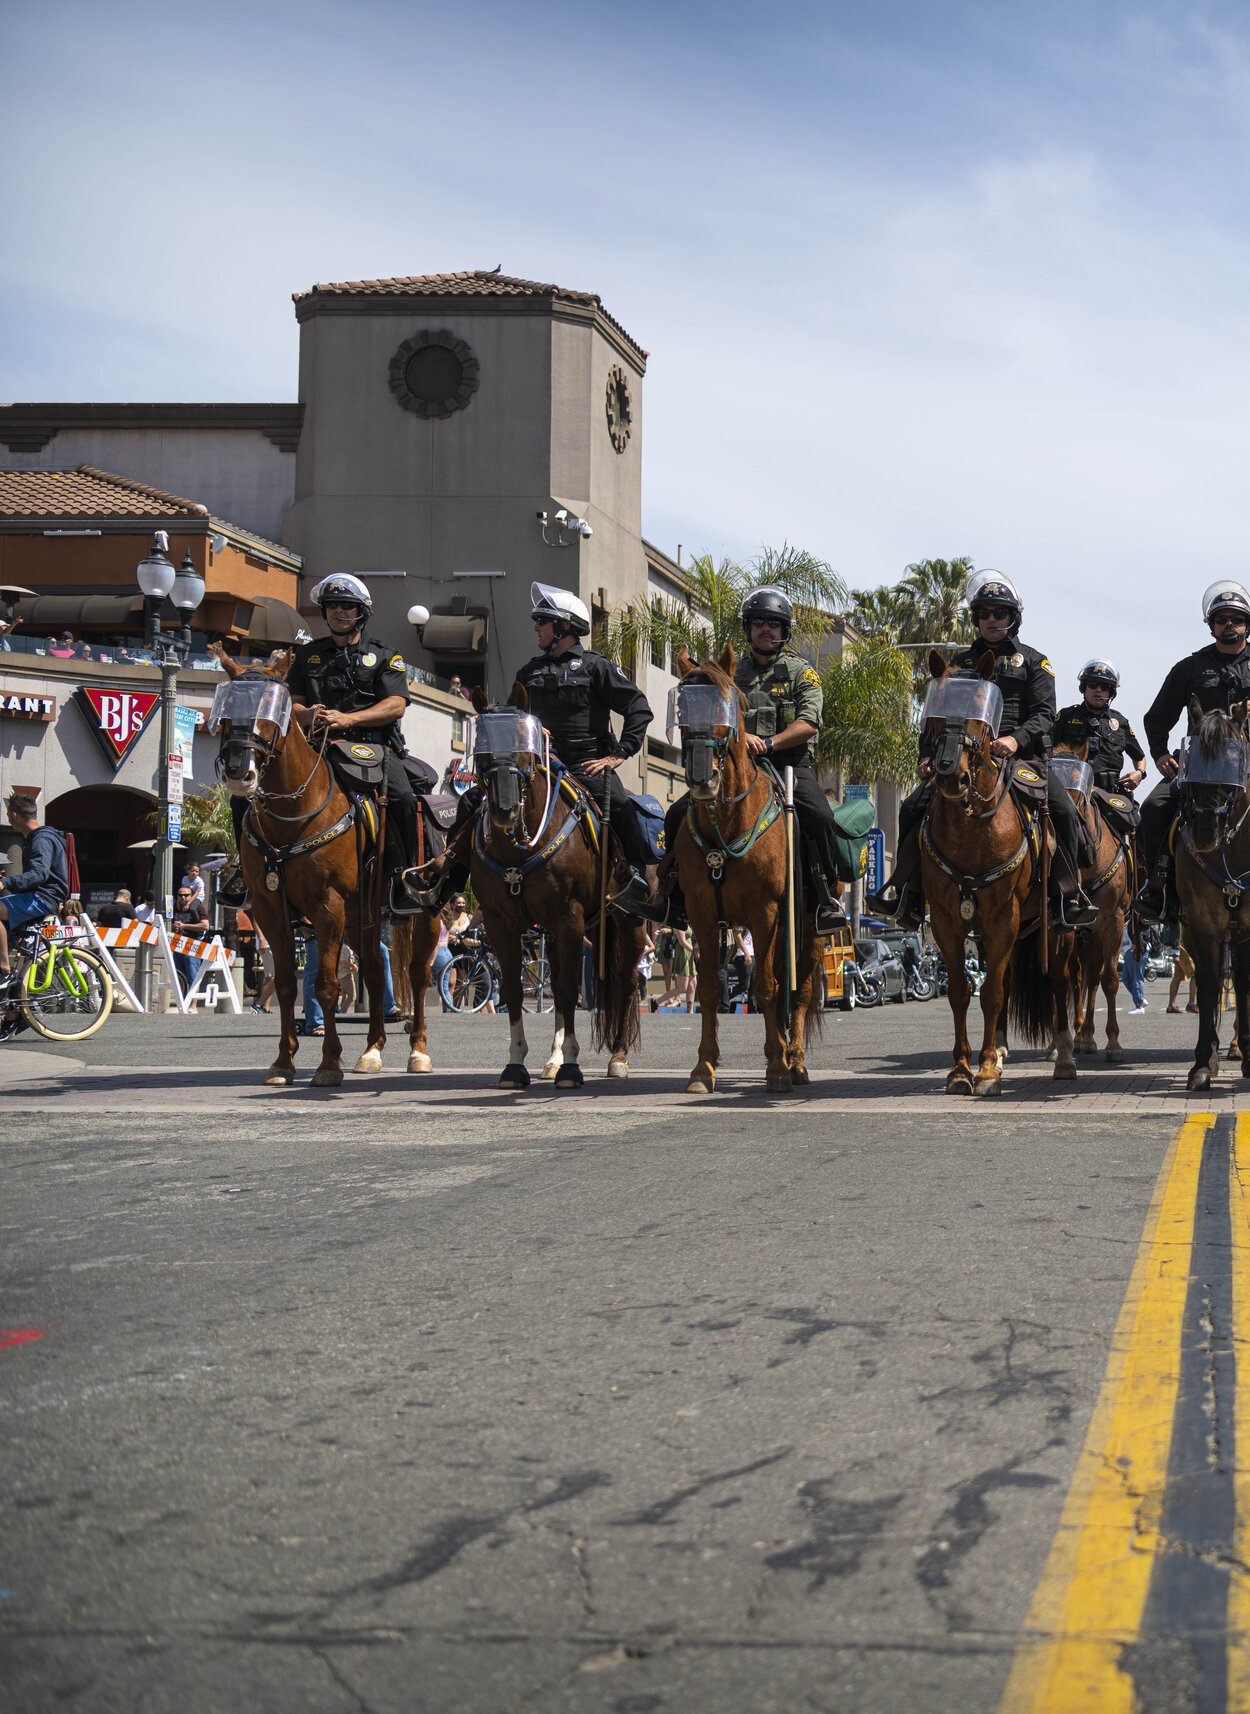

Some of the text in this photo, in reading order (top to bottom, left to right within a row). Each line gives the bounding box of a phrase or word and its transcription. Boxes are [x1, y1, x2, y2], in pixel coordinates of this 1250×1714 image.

[305, 829, 337, 849] POLICE
[541, 832, 566, 859] POLICE
[868, 840, 876, 890] PARKING
[1000, 852, 1024, 876] POLICE
[1101, 863, 1119, 882] POLICE
